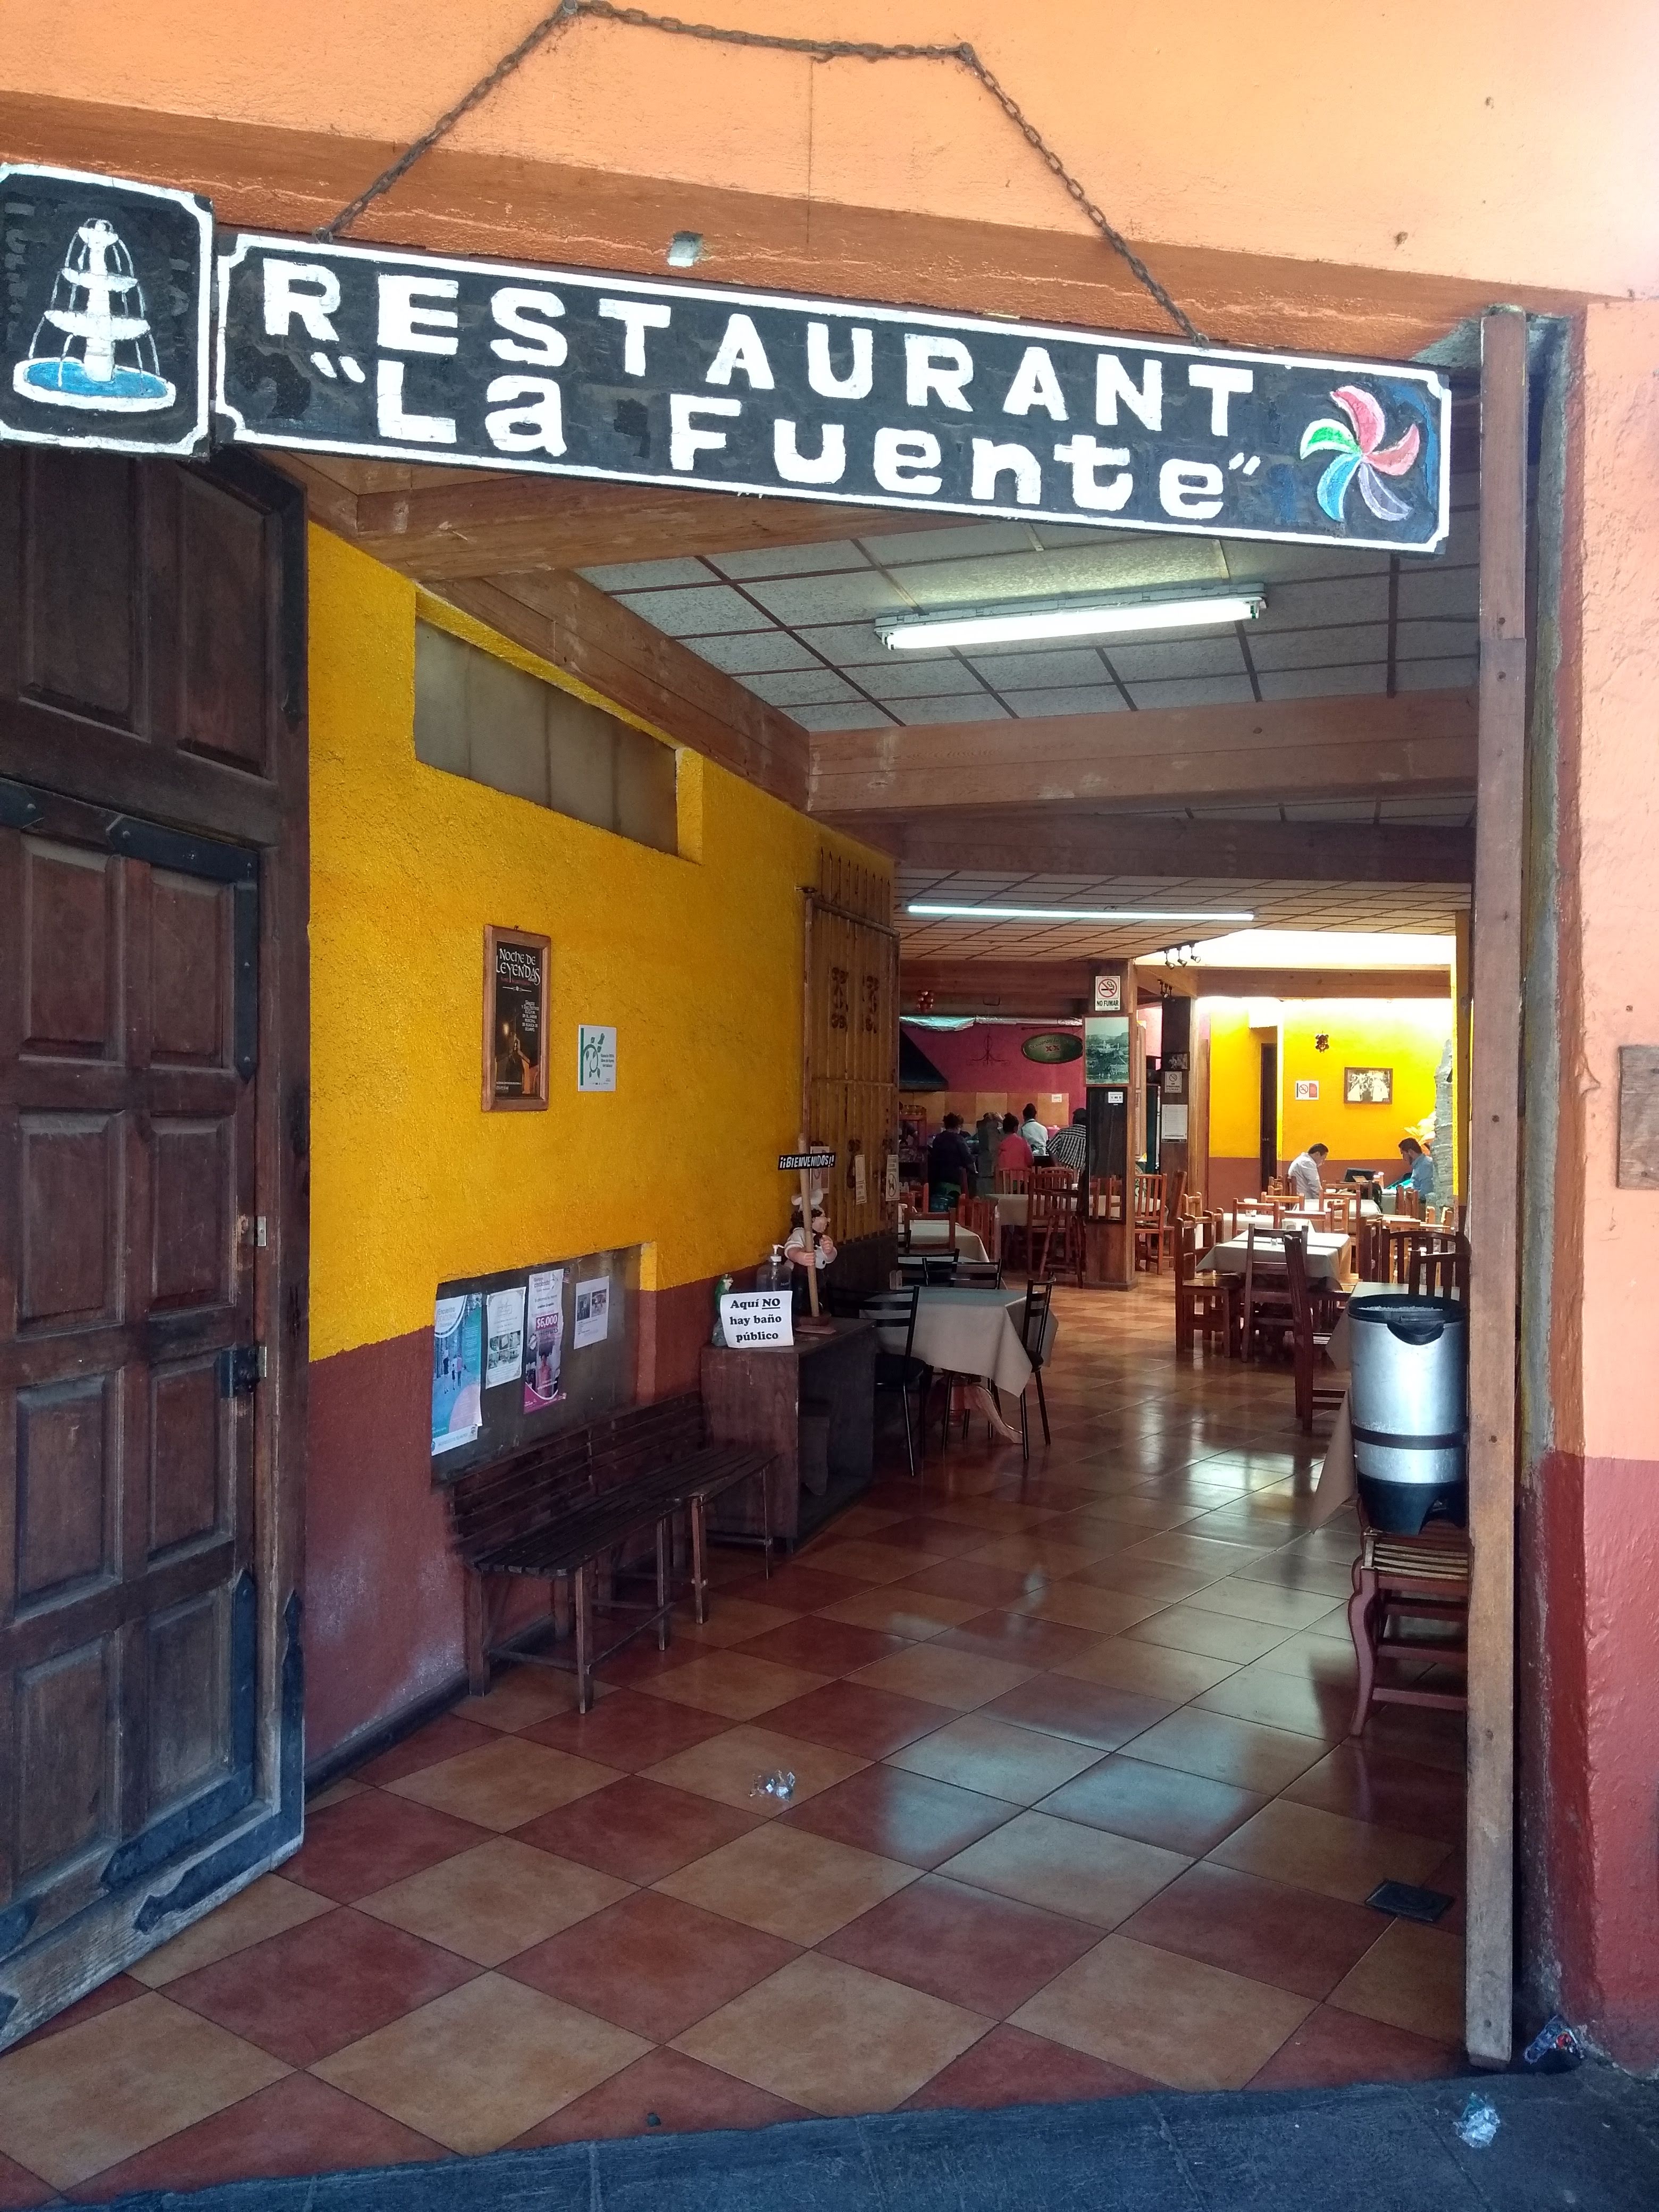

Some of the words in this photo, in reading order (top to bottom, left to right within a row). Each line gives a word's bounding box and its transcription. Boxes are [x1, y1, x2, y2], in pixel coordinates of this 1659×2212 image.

[263, 258, 1253, 436] RESTAURANT
[499, 948, 524, 964] NOCHE
[525, 953, 536, 965] DE
[496, 955, 540, 985] LEYENDAS
[730, 1299, 759, 1310] Aquí
[762, 1298, 781, 1308] NO
[537, 1315, 557, 1329] $6,000
[730, 1317, 750, 1326] hay
[753, 1314, 782, 1323] baño
[736, 1331, 778, 1343] público
